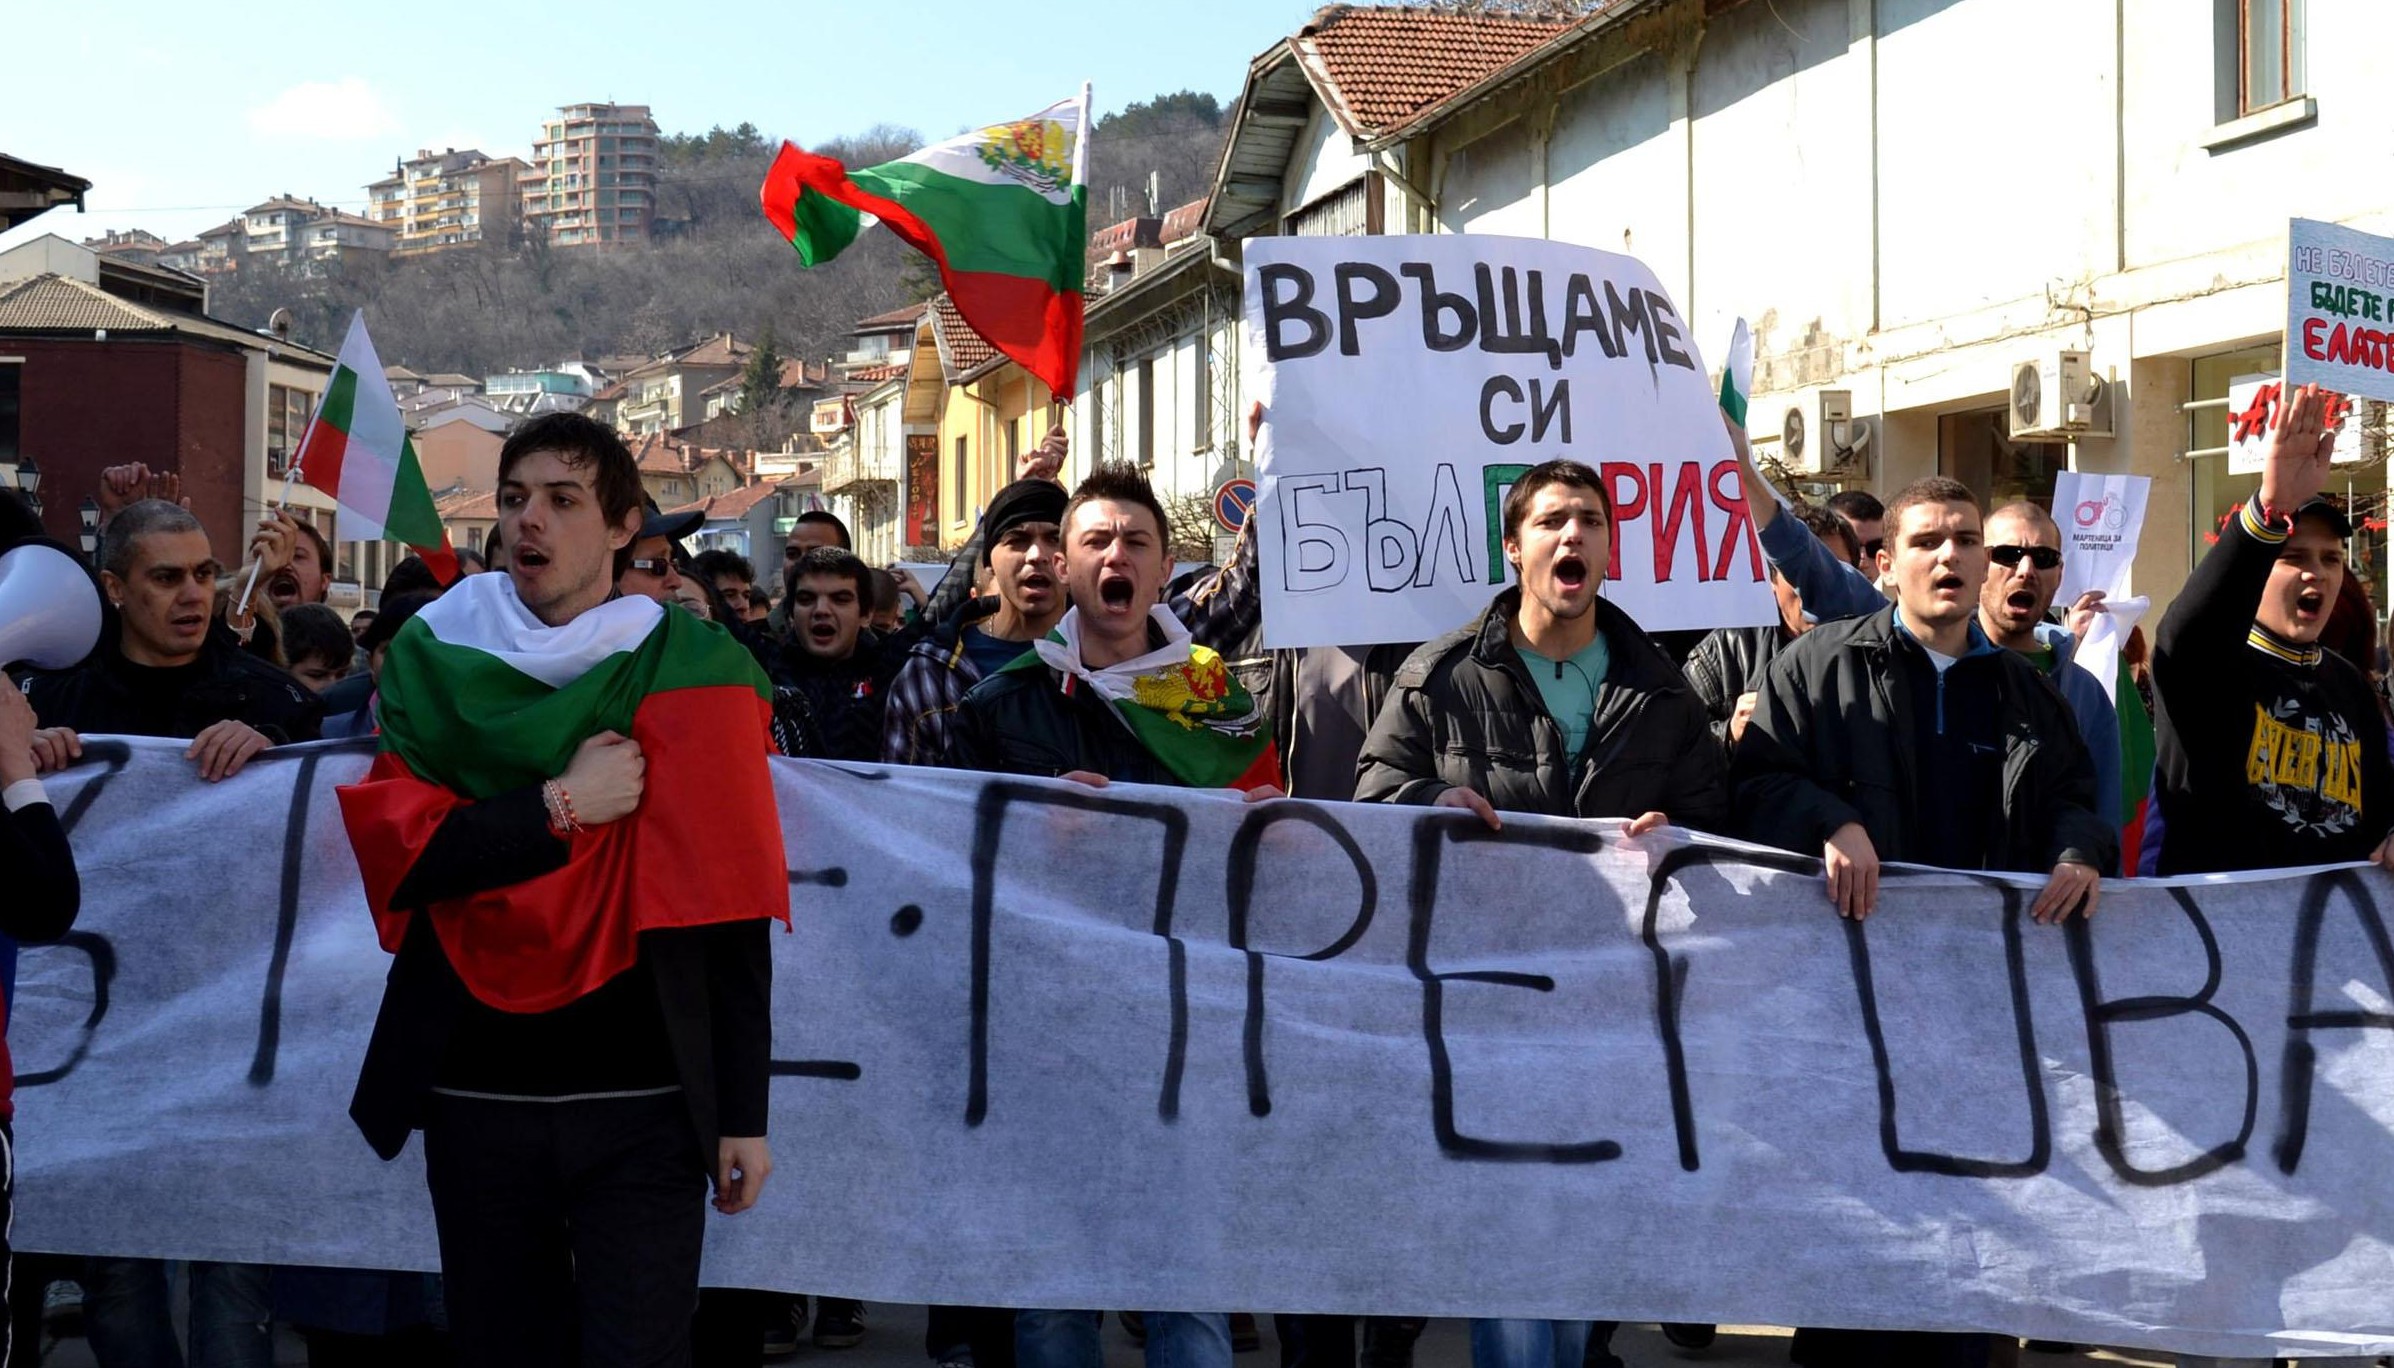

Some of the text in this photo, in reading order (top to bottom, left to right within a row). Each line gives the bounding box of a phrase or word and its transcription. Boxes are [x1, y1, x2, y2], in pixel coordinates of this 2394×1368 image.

[2295, 245, 2322, 274] НЕ
[1258, 261, 1696, 371] ВРЪЩАМЕ
[2311, 280, 2383, 322] БЪДЕТЕ
[1479, 374, 1572, 445] СИ
[1277, 460, 1766, 592] БЪЛГРИЯ
